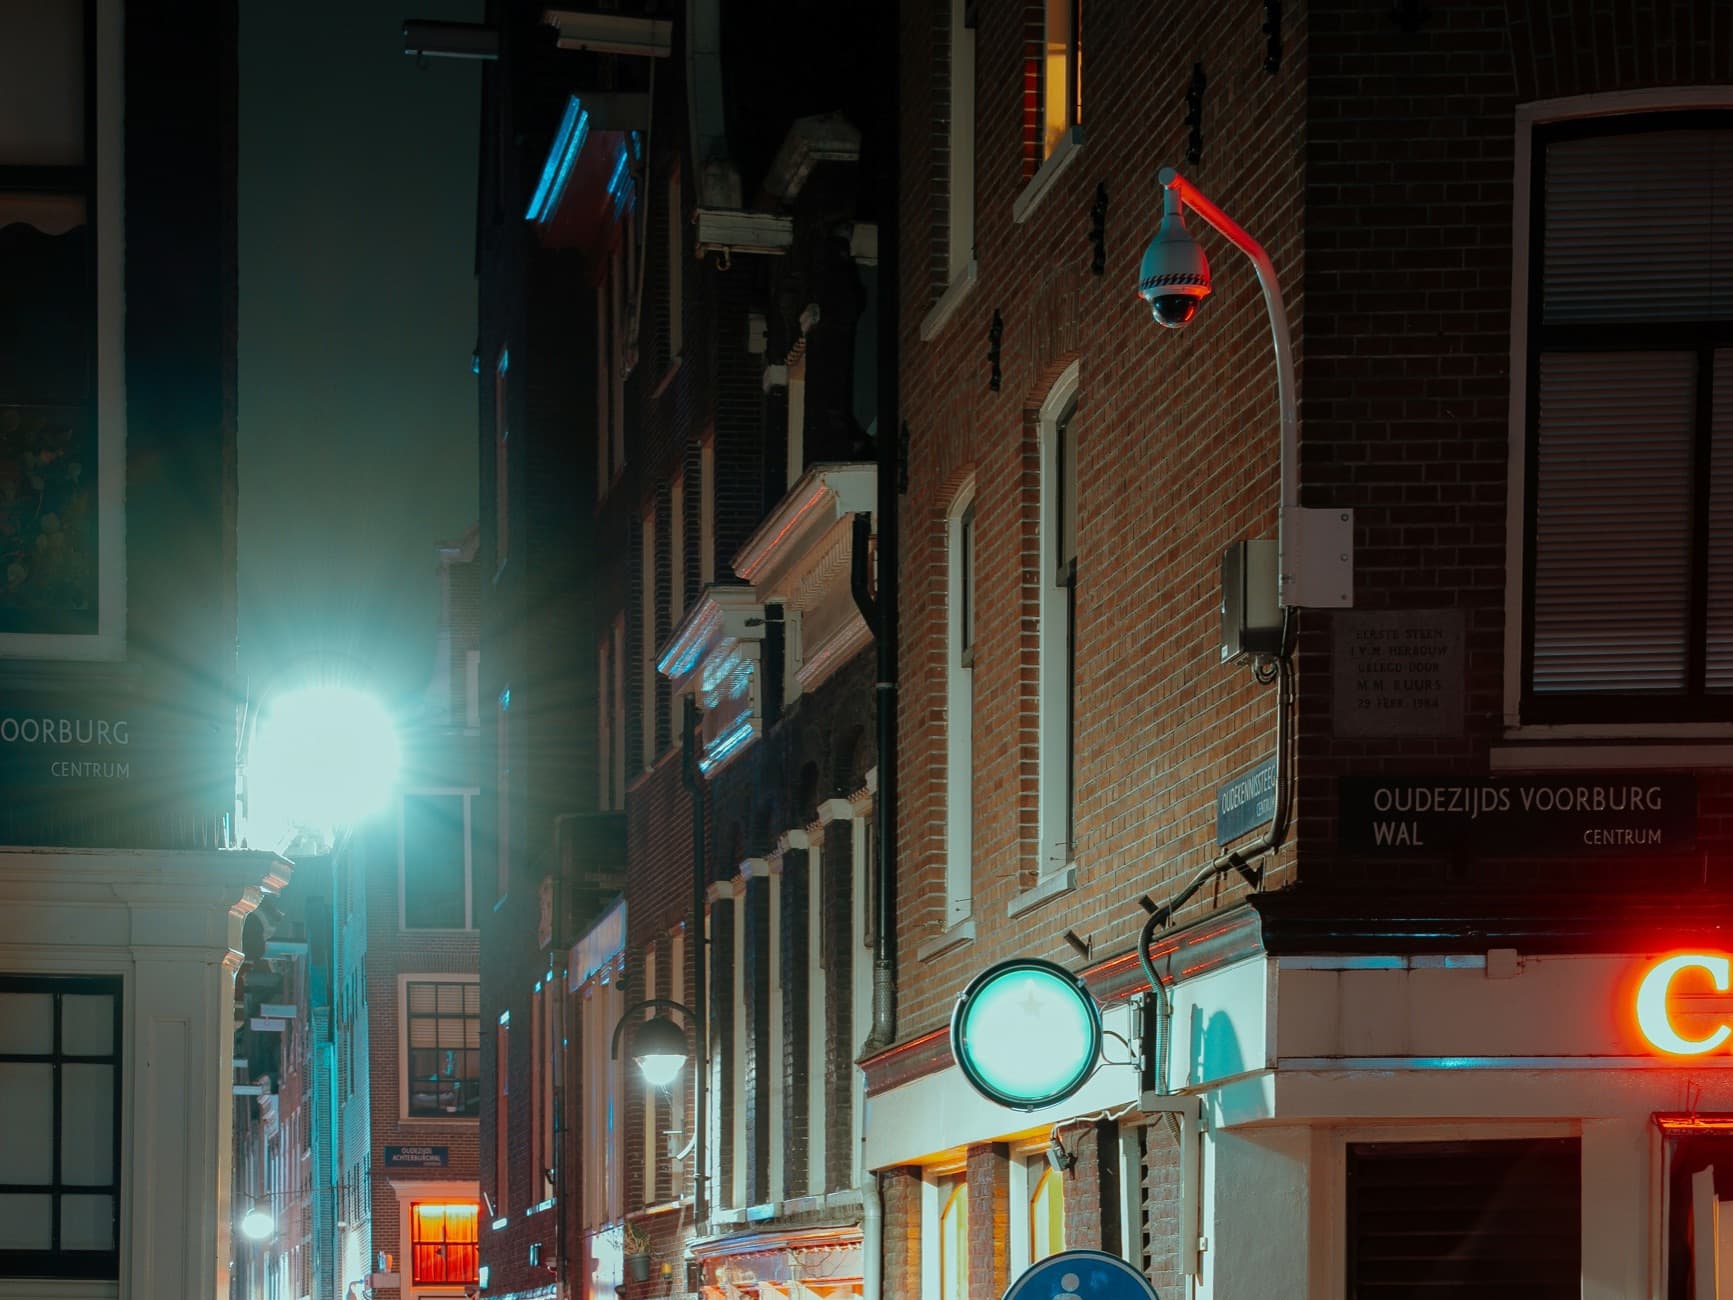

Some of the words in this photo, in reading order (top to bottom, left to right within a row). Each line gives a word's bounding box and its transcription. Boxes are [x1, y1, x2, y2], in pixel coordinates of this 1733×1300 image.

[1408, 661, 1440, 673] DOOR
[0, 717, 129, 745] OORBURG
[51, 761, 130, 778] CENTRUM
[1373, 787, 1510, 819] OUDEZIJDS
[1519, 786, 1662, 811] VOORBURG
[1373, 821, 1424, 846] WAL
[1583, 828, 1662, 845] CENTRUM
[1636, 954, 1732, 1055] C
